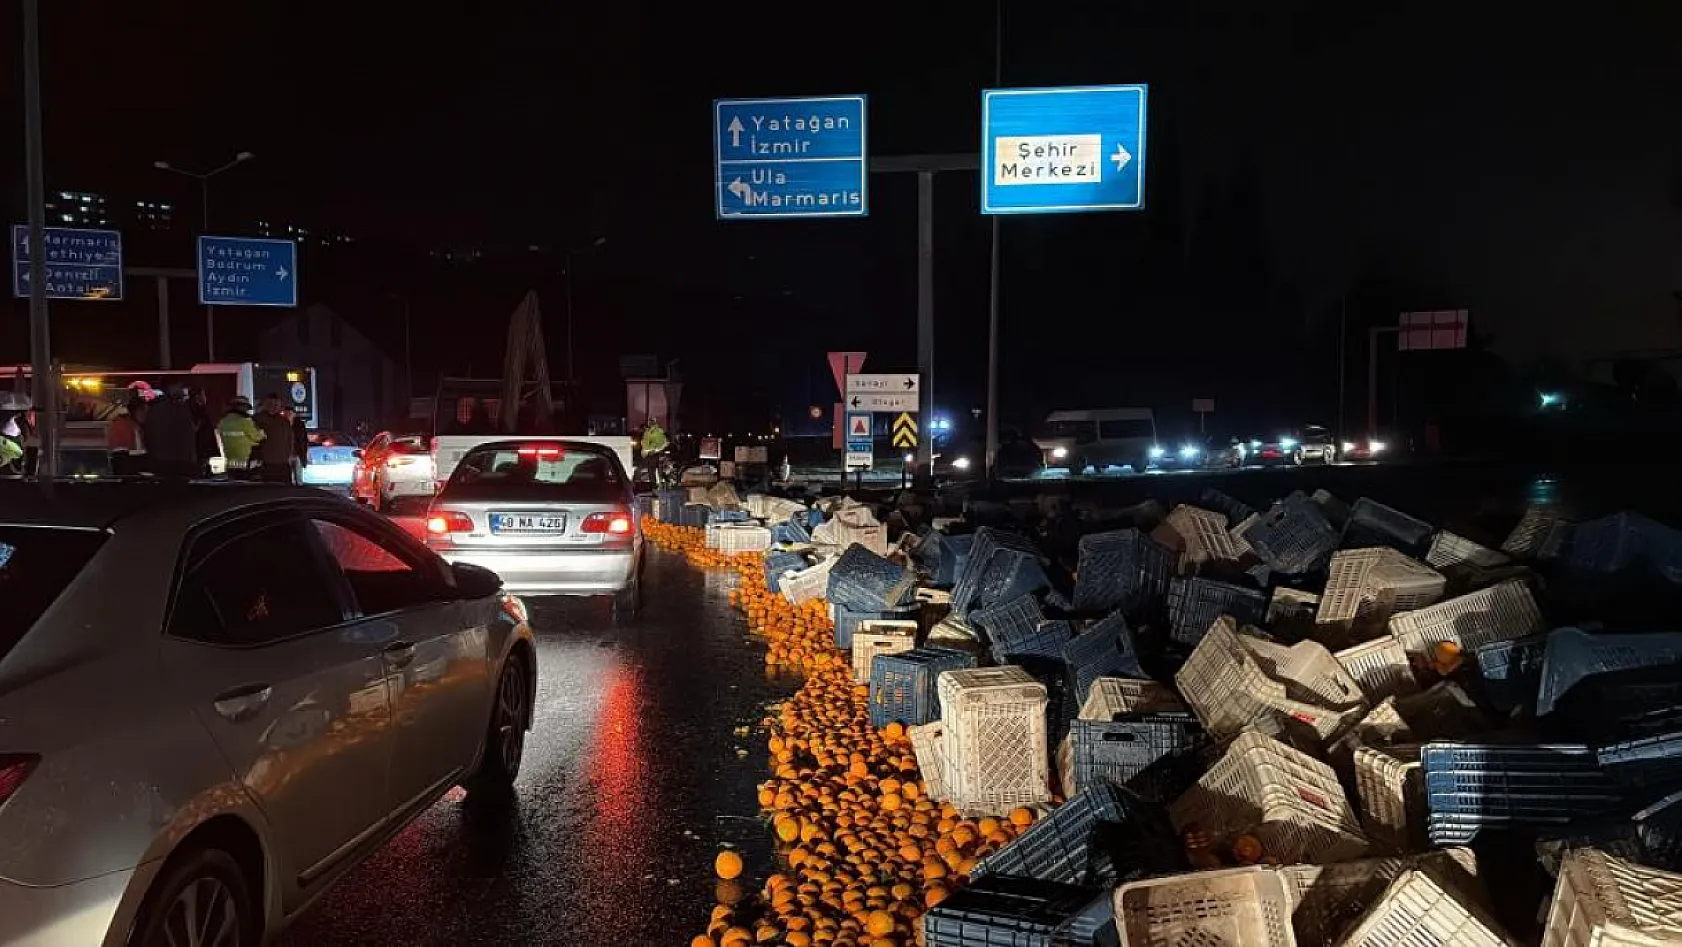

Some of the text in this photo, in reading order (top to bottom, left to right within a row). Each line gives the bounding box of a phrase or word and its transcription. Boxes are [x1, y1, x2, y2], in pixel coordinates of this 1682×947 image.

[752, 114, 849, 134] Yatağan
[751, 134, 810, 154] İzmir
[1018, 142, 1078, 160] Şehir
[752, 168, 786, 185] Ula
[1001, 161, 1095, 178] Merkezi
[753, 190, 859, 207] Marmaris
